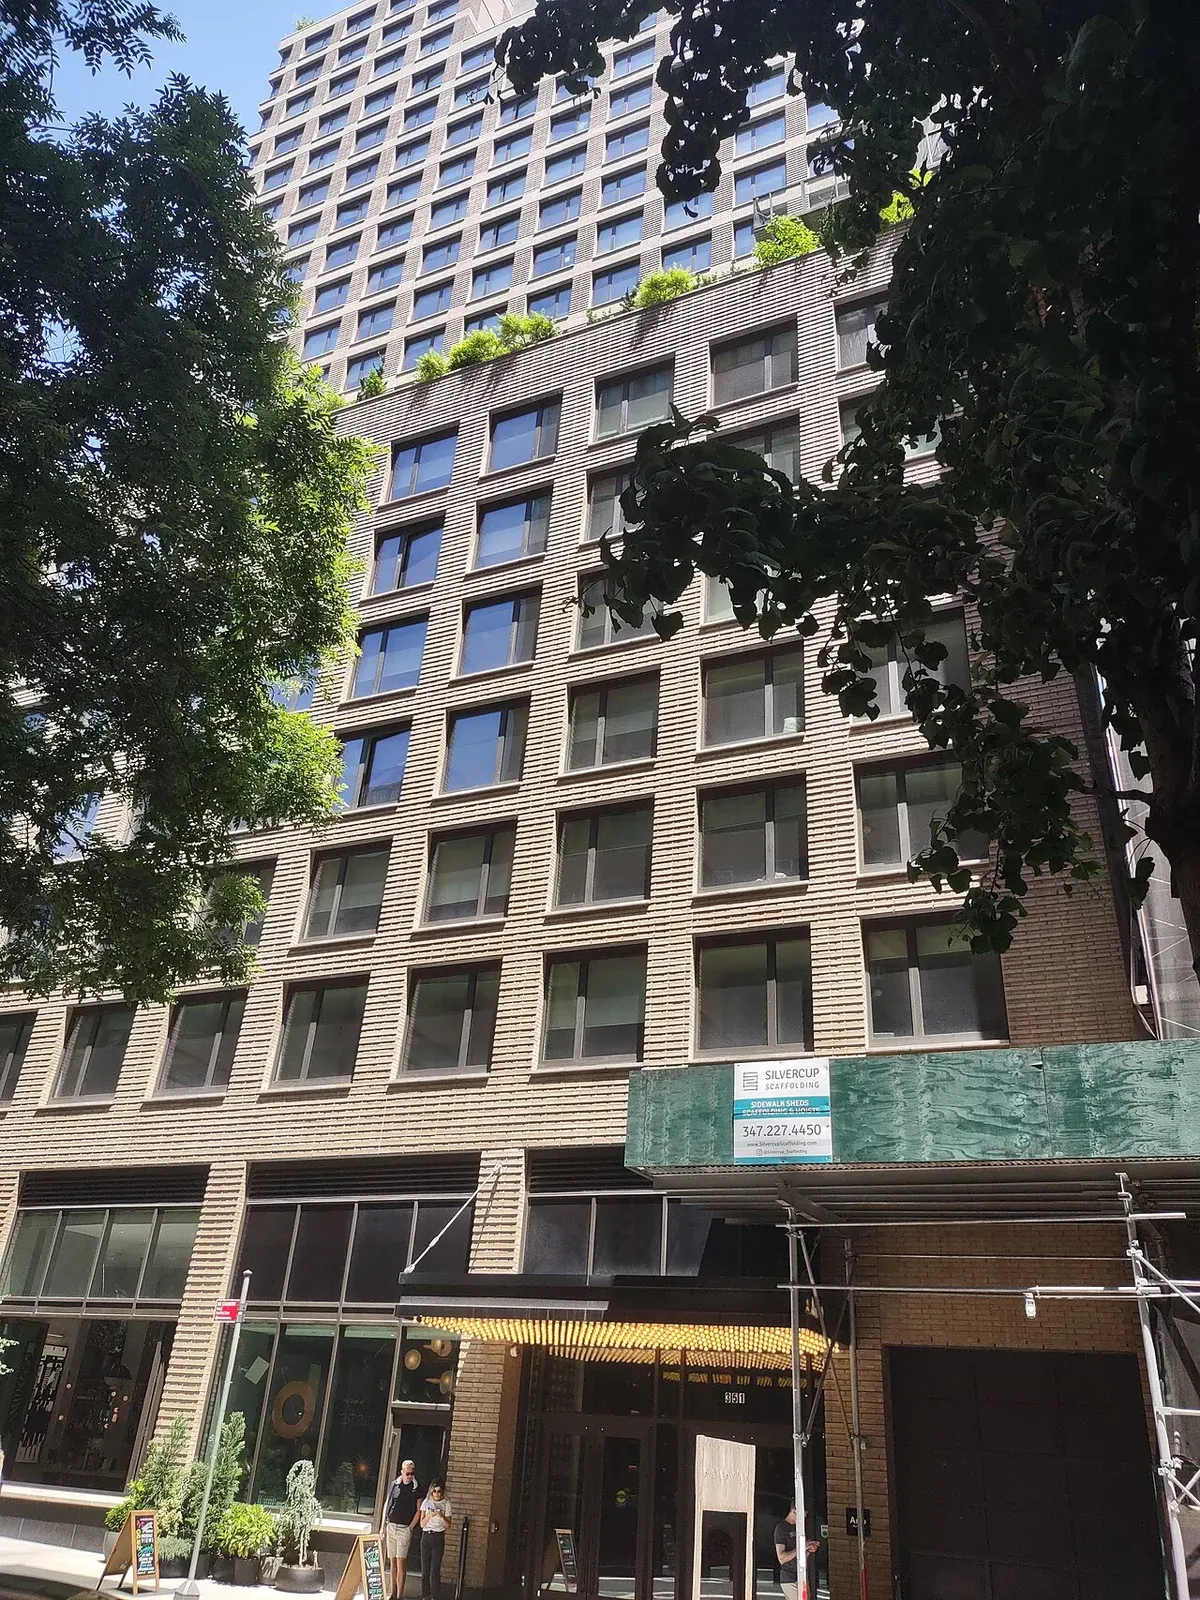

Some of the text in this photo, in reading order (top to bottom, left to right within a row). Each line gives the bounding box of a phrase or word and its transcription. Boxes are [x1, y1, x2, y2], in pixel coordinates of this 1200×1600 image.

[765, 1068, 820, 1080] SILVERCUP
[765, 1081, 820, 1090] SCAFFOLDING
[750, 1099, 810, 1108] SIDEWALK SHEDS
[742, 1108, 788, 1116] SCAFFOLDING
[795, 1107, 820, 1115] HOISTS
[742, 1124, 821, 1138] 347.227.4450
[725, 1391, 745, 1404] 351
